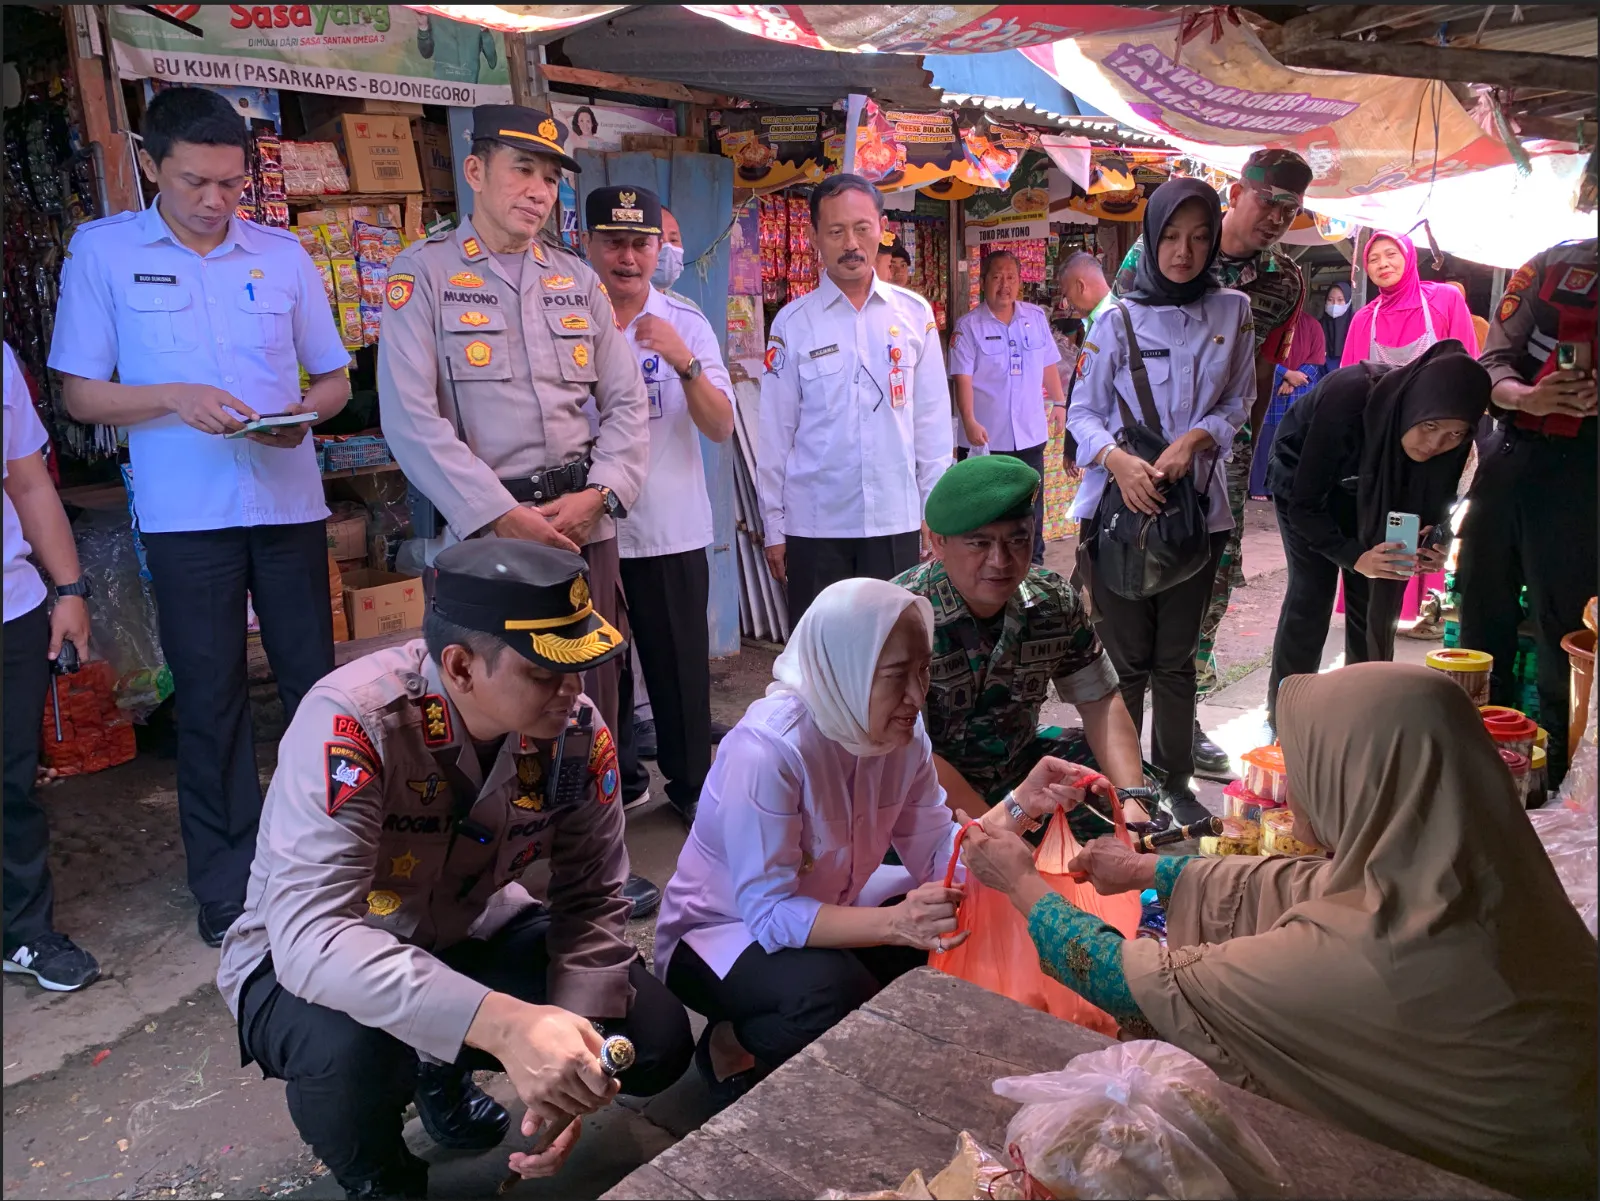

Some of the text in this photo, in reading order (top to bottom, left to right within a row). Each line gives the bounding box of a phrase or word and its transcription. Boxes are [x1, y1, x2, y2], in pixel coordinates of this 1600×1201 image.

[248, 35, 385, 47] DIMULAI DARI SASA SANTAN OMEGA 3
[153, 57, 180, 76] BU
[184, 60, 231, 79] KUM
[896, 124, 921, 132] CHEESE
[980, 226, 1030, 240] TOKO PAK YONO
[444, 291, 499, 306] MULYONO
[543, 295, 589, 307] POLRI
[1030, 643, 1051, 657] TNI
[338, 719, 371, 744] PELO
